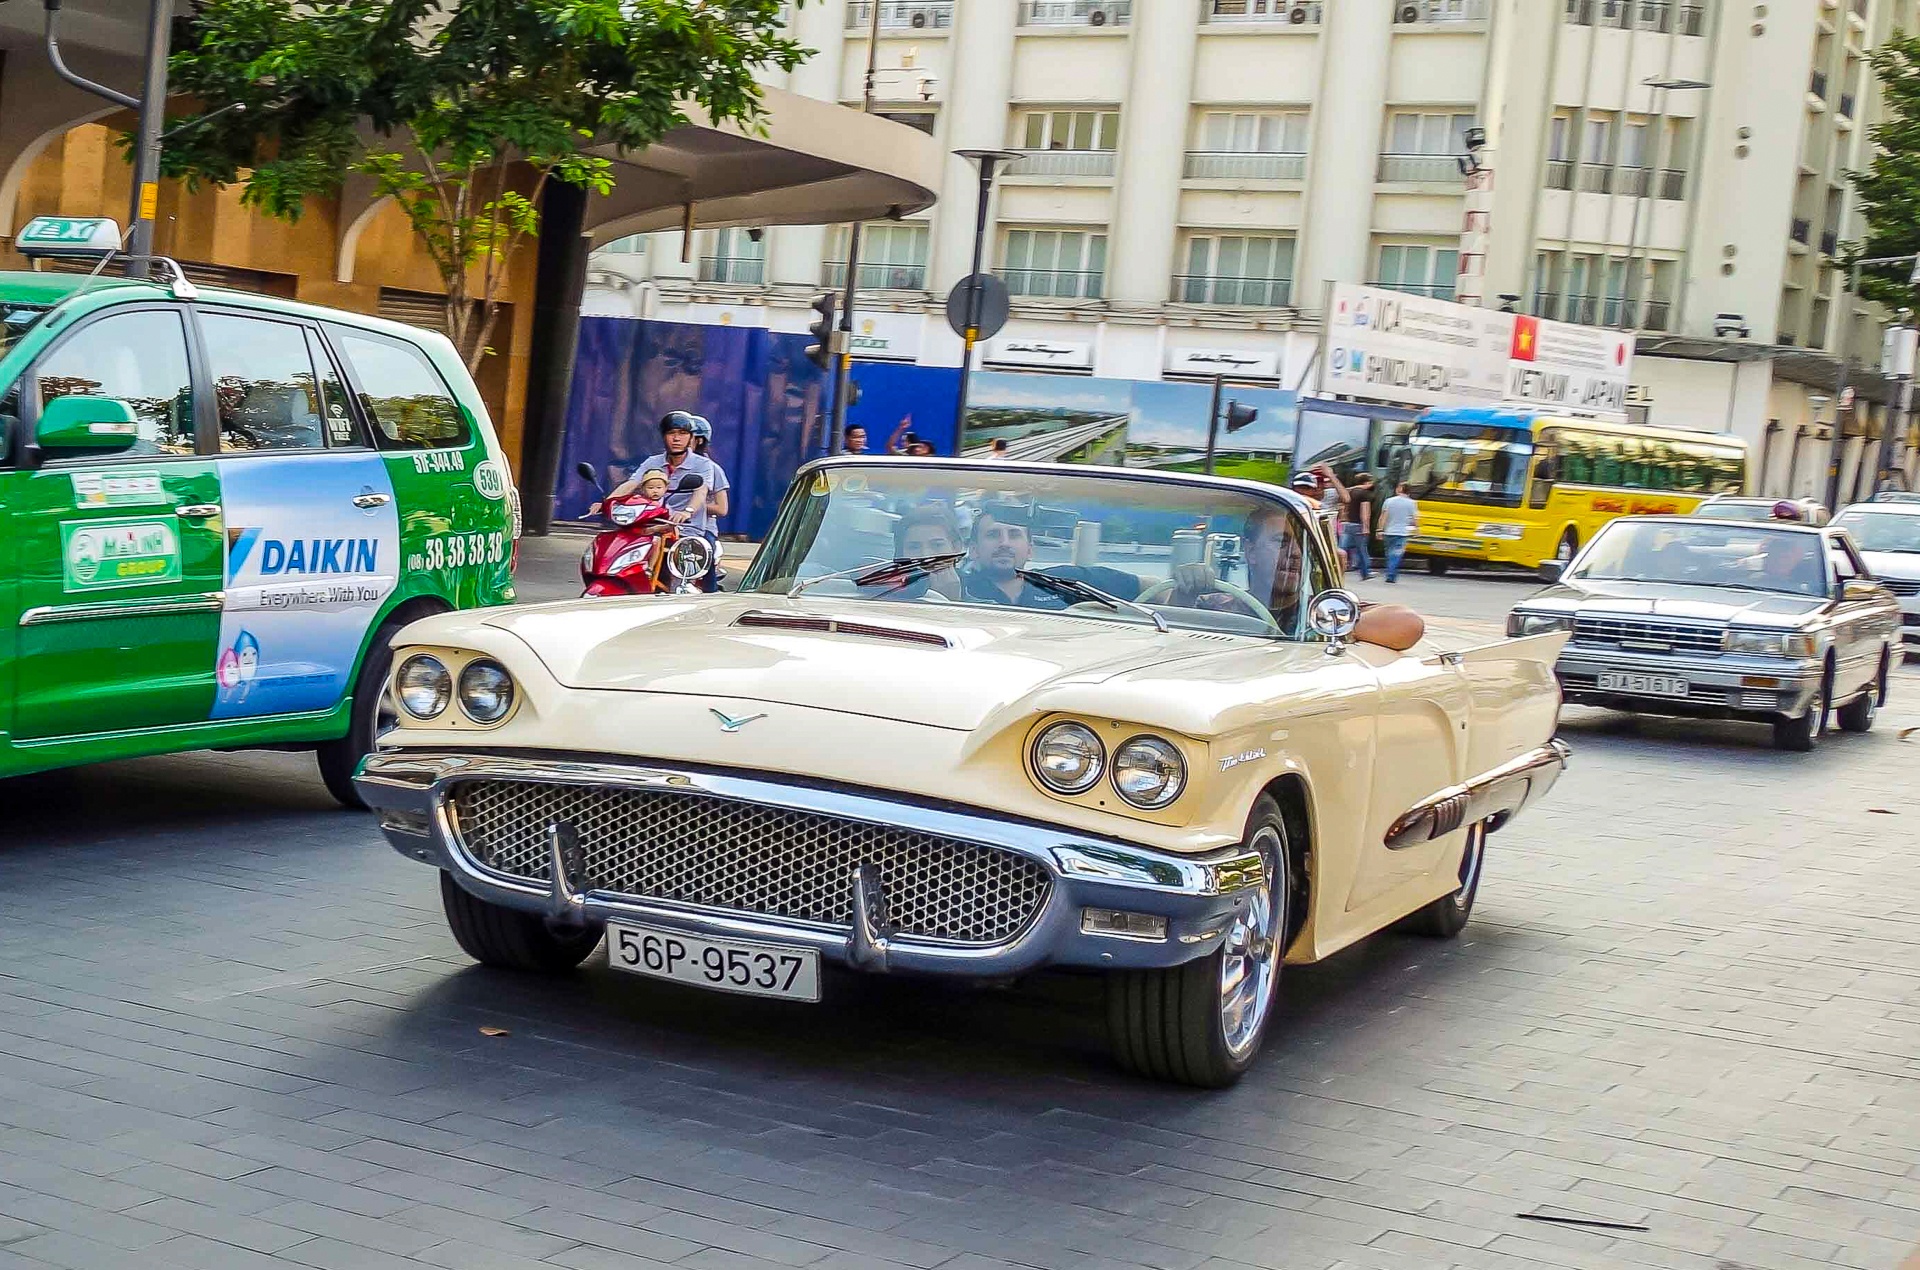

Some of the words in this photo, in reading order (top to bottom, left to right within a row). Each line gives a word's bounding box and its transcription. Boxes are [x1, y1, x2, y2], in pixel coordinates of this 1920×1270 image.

[260, 539, 378, 574] DAIKIN
[425, 538, 444, 570] 38
[447, 535, 465, 568] 38
[468, 533, 485, 565] 38
[486, 531, 503, 563] 38
[327, 586, 354, 602] With
[356, 586, 378, 601] You
[618, 929, 803, 992] 56P-9537
